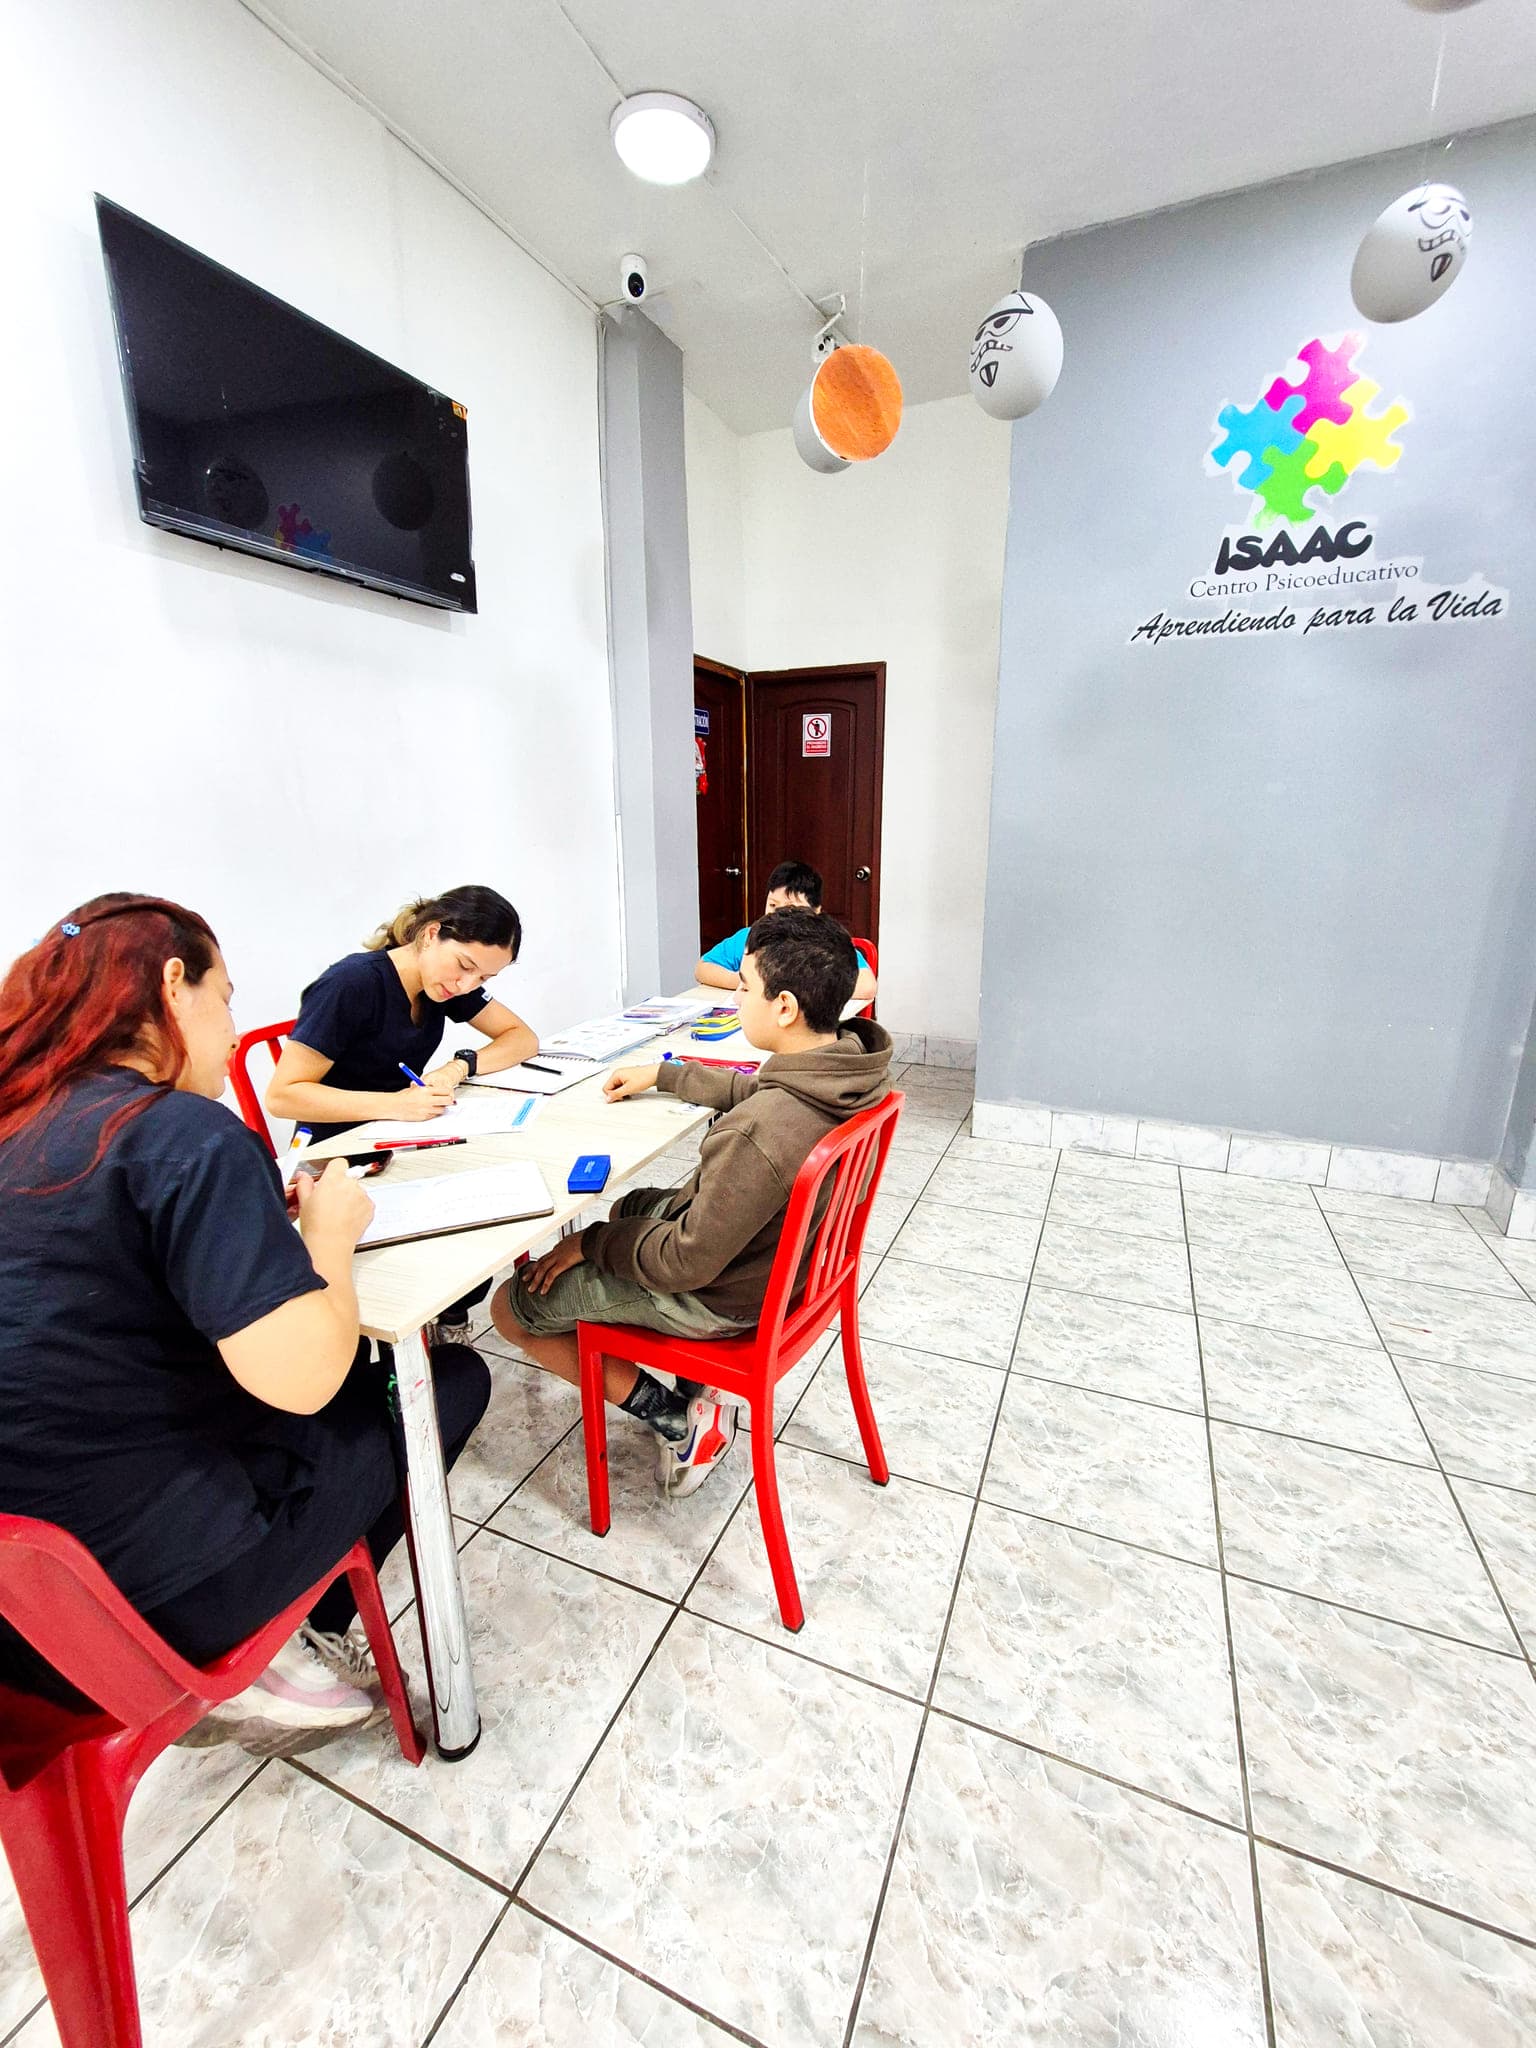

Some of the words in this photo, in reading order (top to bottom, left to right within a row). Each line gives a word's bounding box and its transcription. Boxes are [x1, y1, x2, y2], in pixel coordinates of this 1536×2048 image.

[1214, 521, 1373, 575] ISAAC
[1190, 580, 1258, 598] Centro
[1266, 563, 1418, 591] Psicoeducativo
[1131, 605, 1296, 645] Aprendiendo
[1303, 607, 1376, 635] para
[1387, 596, 1419, 623] la
[1426, 590, 1502, 621] Vida
